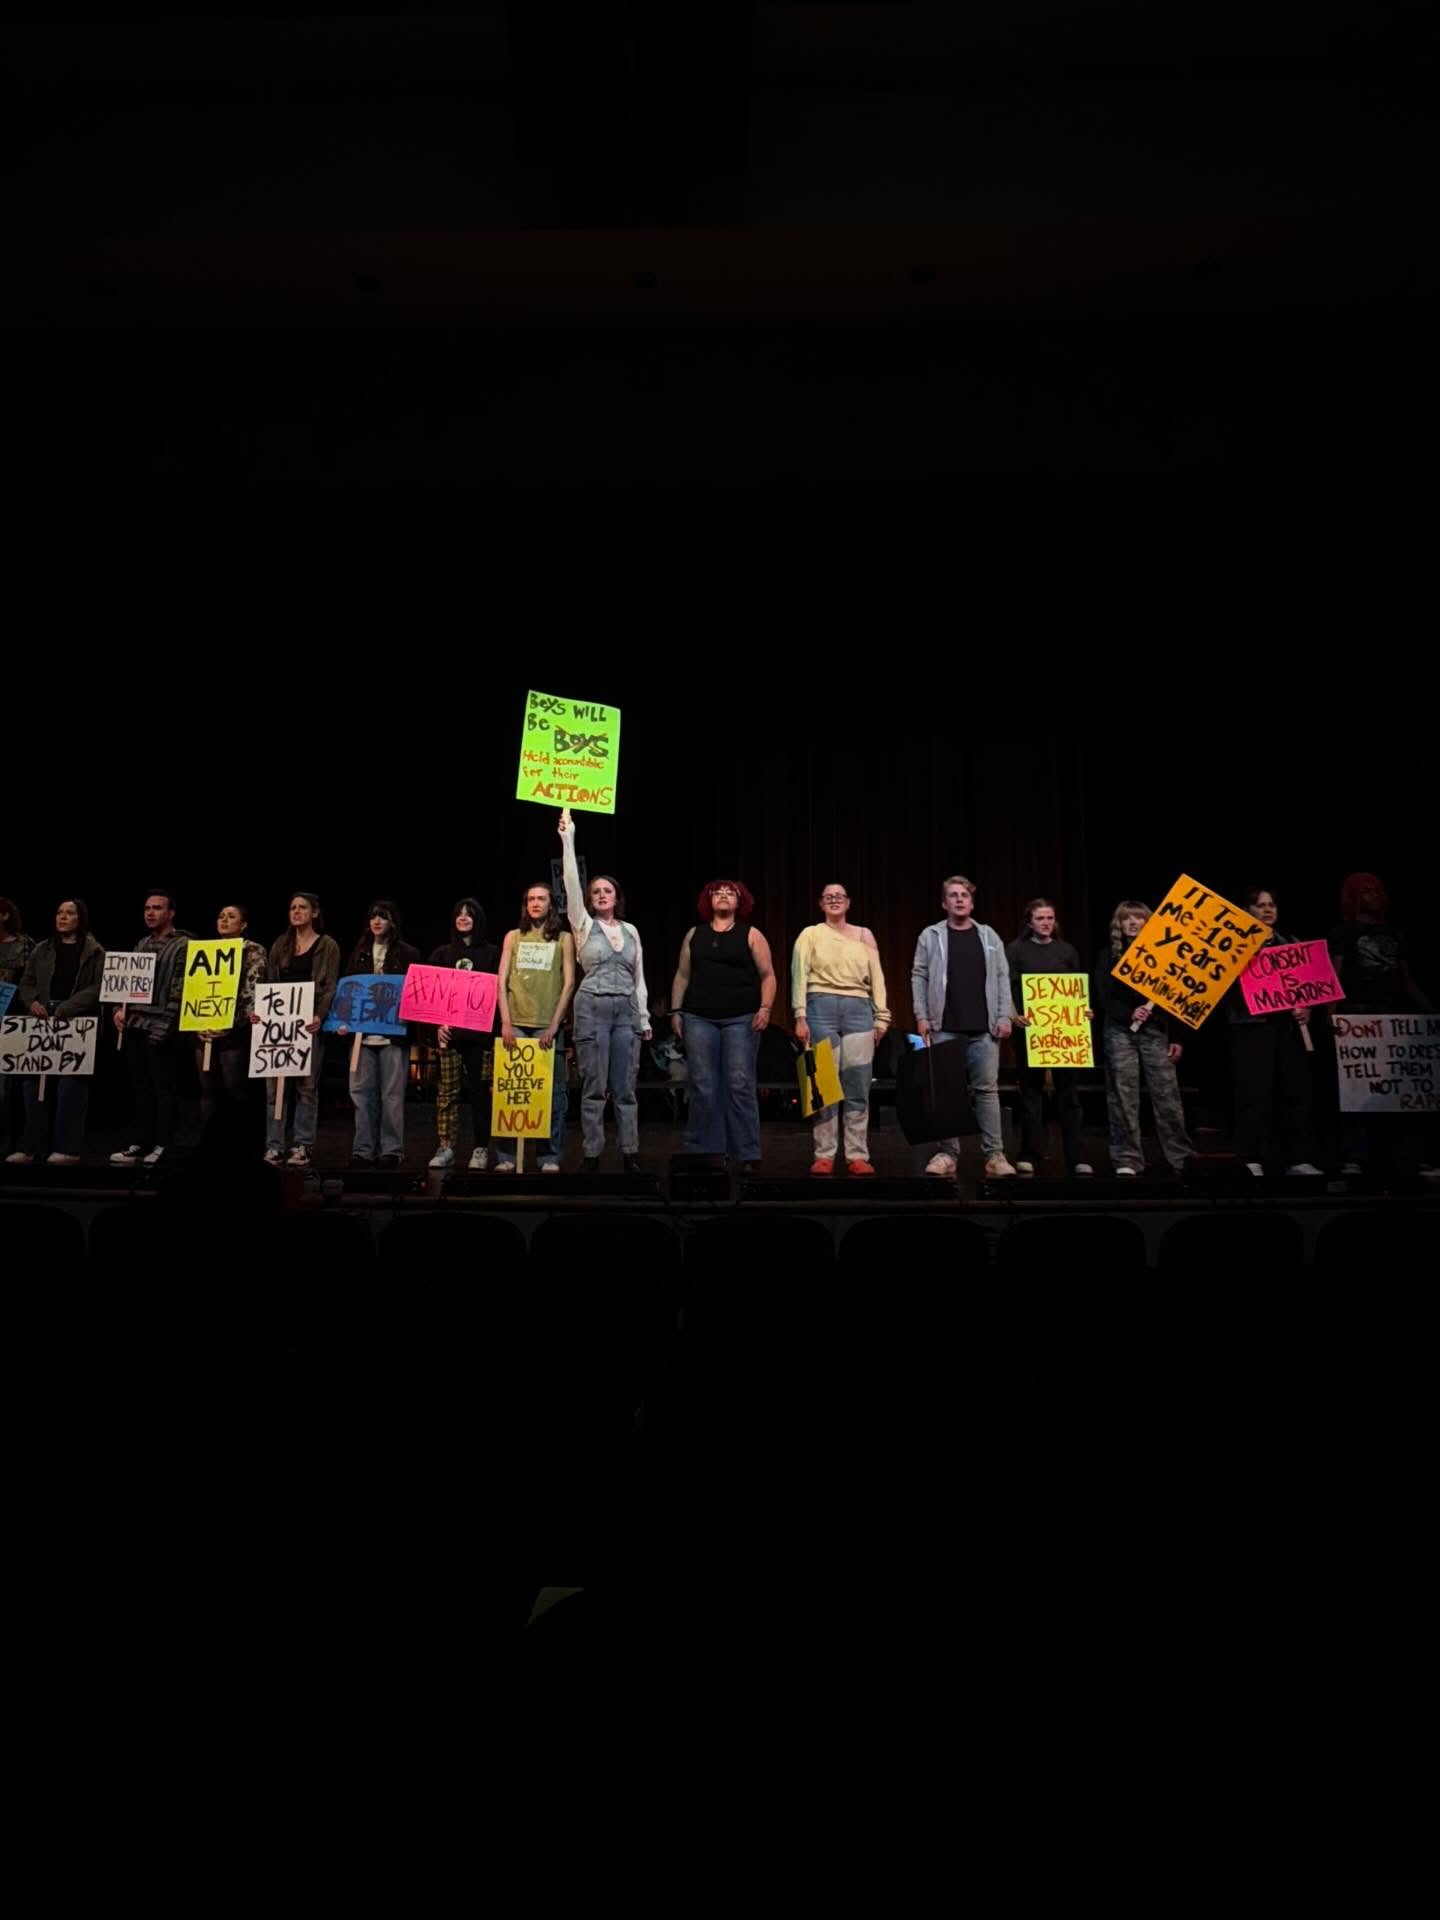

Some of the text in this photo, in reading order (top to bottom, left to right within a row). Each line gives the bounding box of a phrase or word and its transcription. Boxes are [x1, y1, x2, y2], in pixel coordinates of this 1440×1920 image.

[573, 705, 607, 722] WILL
[532, 781, 613, 806] ACTIONS
[1184, 886, 1214, 909] IT
[130, 955, 153, 971] NOT
[188, 947, 235, 977] AM
[1134, 944, 1207, 997] to stop
[1247, 945, 1313, 979] CONSENT
[103, 974, 129, 993] YOUR
[206, 980, 222, 999] I
[1025, 977, 1087, 1001] SEXUAL
[1281, 974, 1300, 988] IS
[183, 997, 234, 1017] NEXT
[3, 1016, 95, 1042] STAND UP
[261, 1018, 309, 1044] YOUR
[1390, 1018, 1422, 1037] TELL
[254, 1046, 312, 1074] STORY
[511, 1044, 535, 1063] DO
[1338, 1045, 1377, 1059] HOW
[1386, 1044, 1406, 1058] TO
[2, 1050, 87, 1073] STAND BY
[503, 1061, 535, 1079] YOU
[1343, 1061, 1433, 1079] TELL THEM
[496, 1077, 544, 1092] BELIEVE
[1368, 1079, 1434, 1095] NOT TO
[506, 1090, 532, 1105] HER
[497, 1108, 544, 1133] NOW
